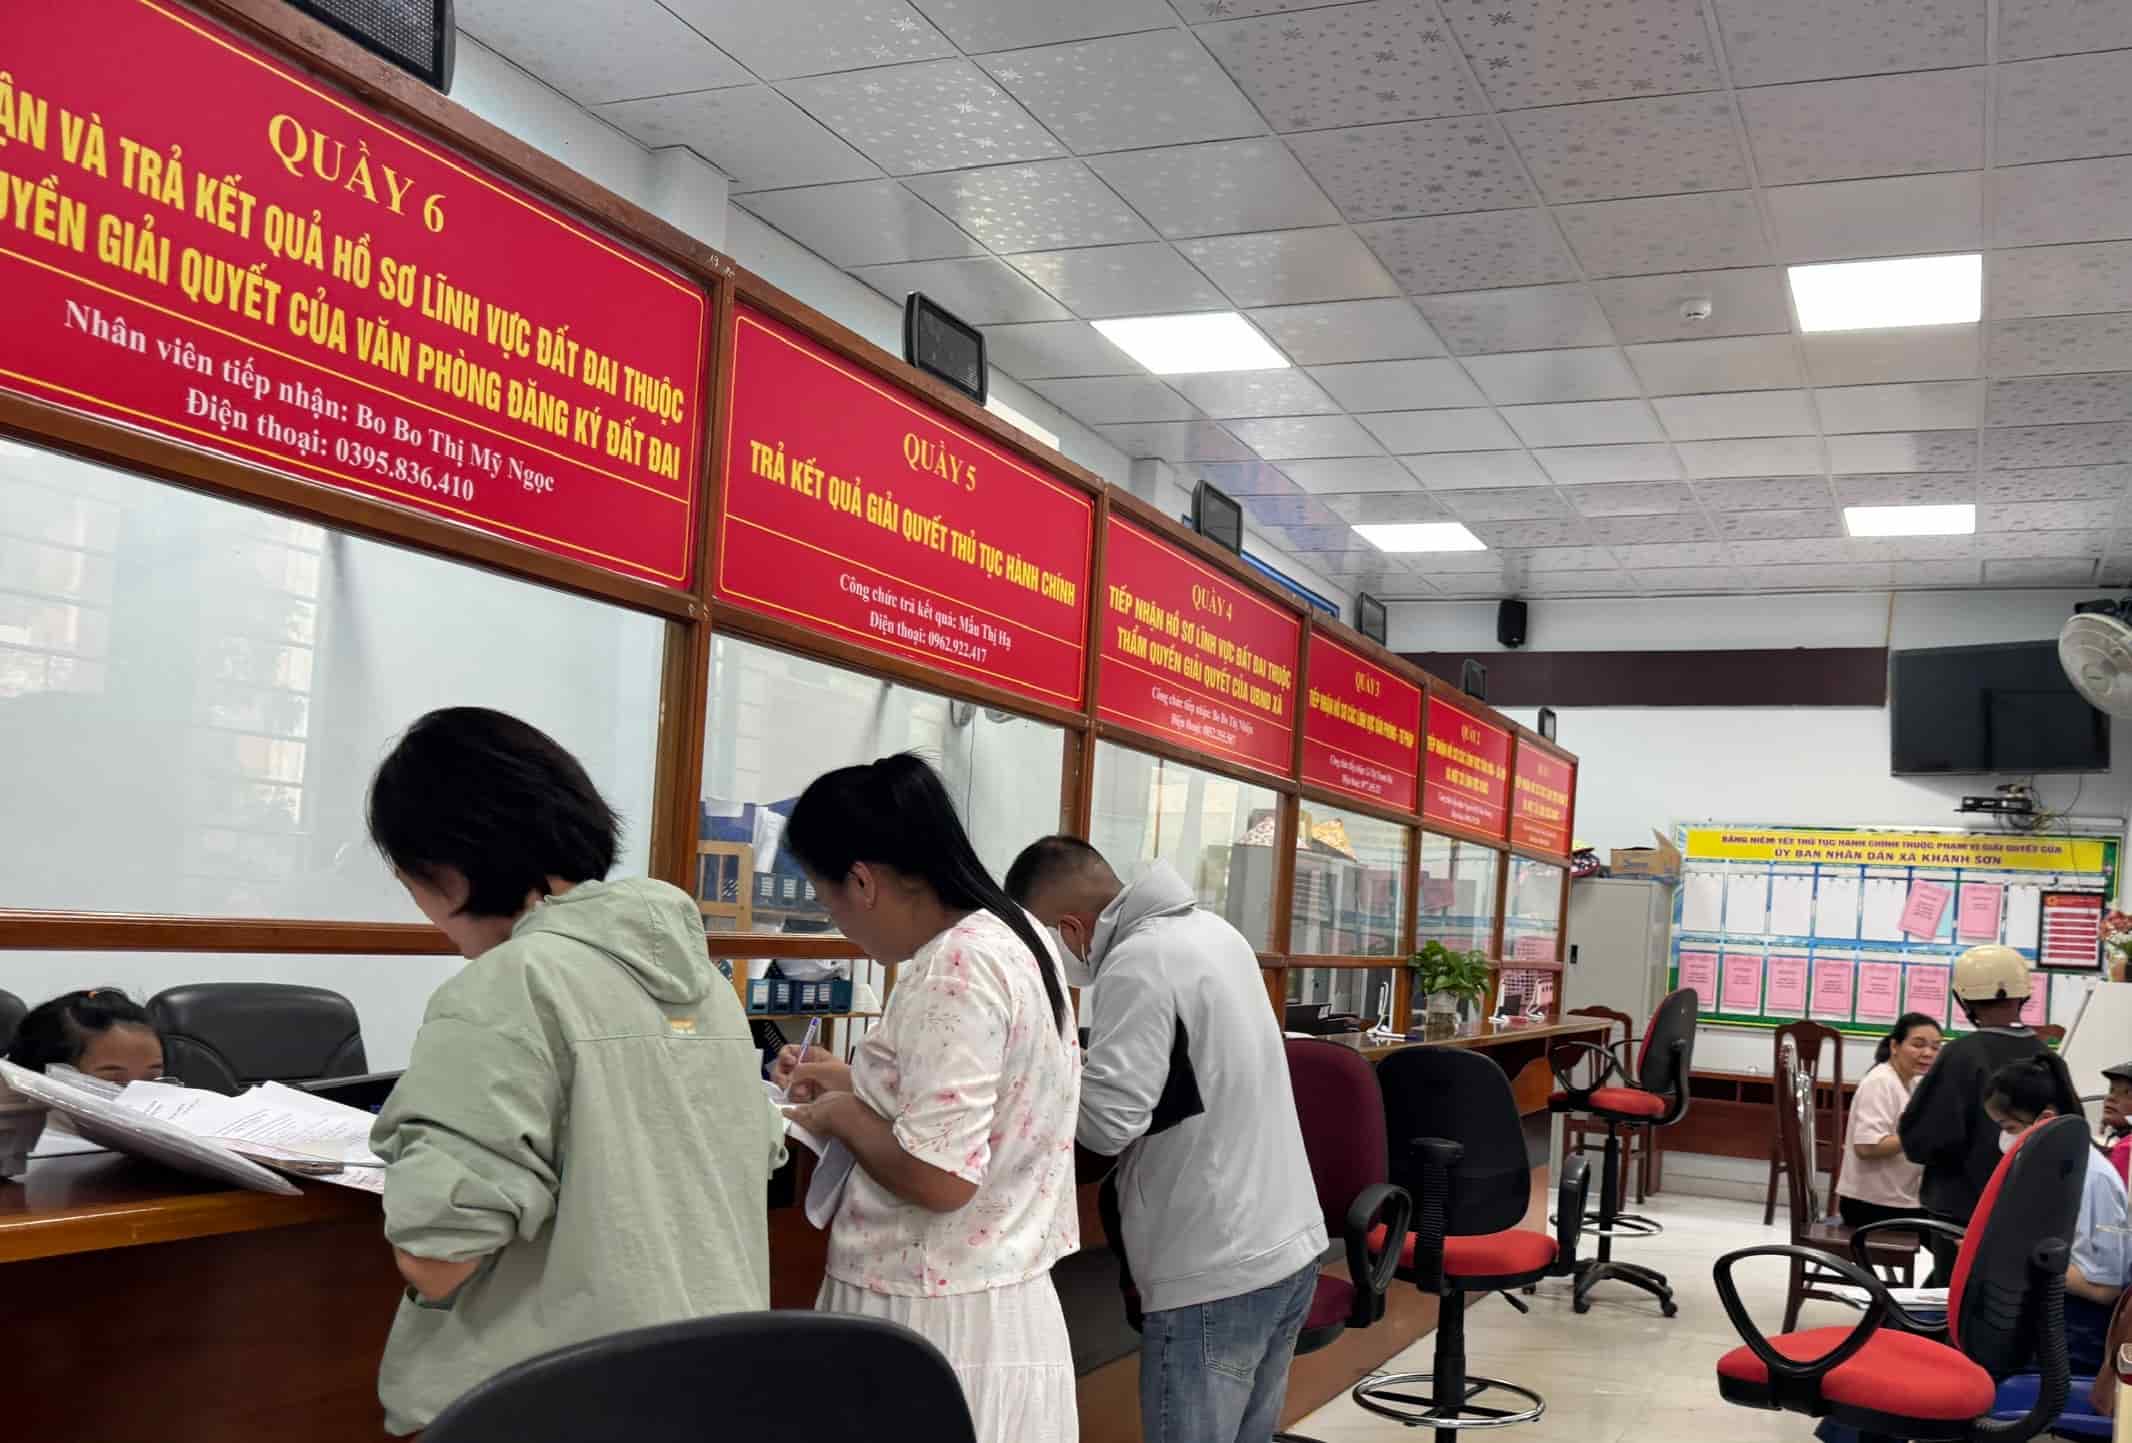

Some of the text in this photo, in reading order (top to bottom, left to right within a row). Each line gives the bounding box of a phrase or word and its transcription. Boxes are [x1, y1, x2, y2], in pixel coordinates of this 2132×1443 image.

[268, 113, 446, 233] QUẦY 6
[60, 107, 108, 178] VÀ
[119, 136, 185, 211] TRẢ
[195, 171, 256, 240] KẾT
[264, 204, 324, 271] QUẢ
[332, 232, 371, 288] HỒ
[379, 256, 417, 308] SƠ
[421, 272, 480, 336] LĨNH
[486, 303, 532, 360] VỰC
[536, 325, 579, 378] ĐẤT
[583, 347, 619, 396] ĐAI
[623, 365, 685, 425] THUỘC
[63, 299, 555, 494] Nhân viên tiếp nhận: Bo Bo Thị Mỹ Ngọc
[98, 213, 170, 286] GIẢI
[180, 247, 282, 326] QUYẾT
[289, 286, 346, 353] CỦA
[355, 315, 410, 377] VĂN
[416, 342, 501, 413] PHÒNG
[507, 377, 569, 437] ĐĂNG
[573, 405, 602, 449] KÝ
[606, 416, 645, 466] ĐẤT
[648, 436, 680, 480] ĐAI
[186, 387, 474, 501] Điện thoại: 0395.836.410
[965, 465, 977, 492] 5
[750, 439, 1076, 608] TRẢ KẾT QUẢ GIẢI QUYẾT THỦ TỤC HÀNH CHÍNH
[839, 573, 870, 602] Công
[872, 586, 898, 607] chức
[900, 596, 915, 614] trả
[917, 598, 933, 620] kết
[982, 623, 997, 647] Thị
[869, 610, 895, 636] Điện
[897, 620, 926, 646] thoại:
[1109, 584, 1133, 615] TIẾP
[1795, 848, 1821, 858] BAN
